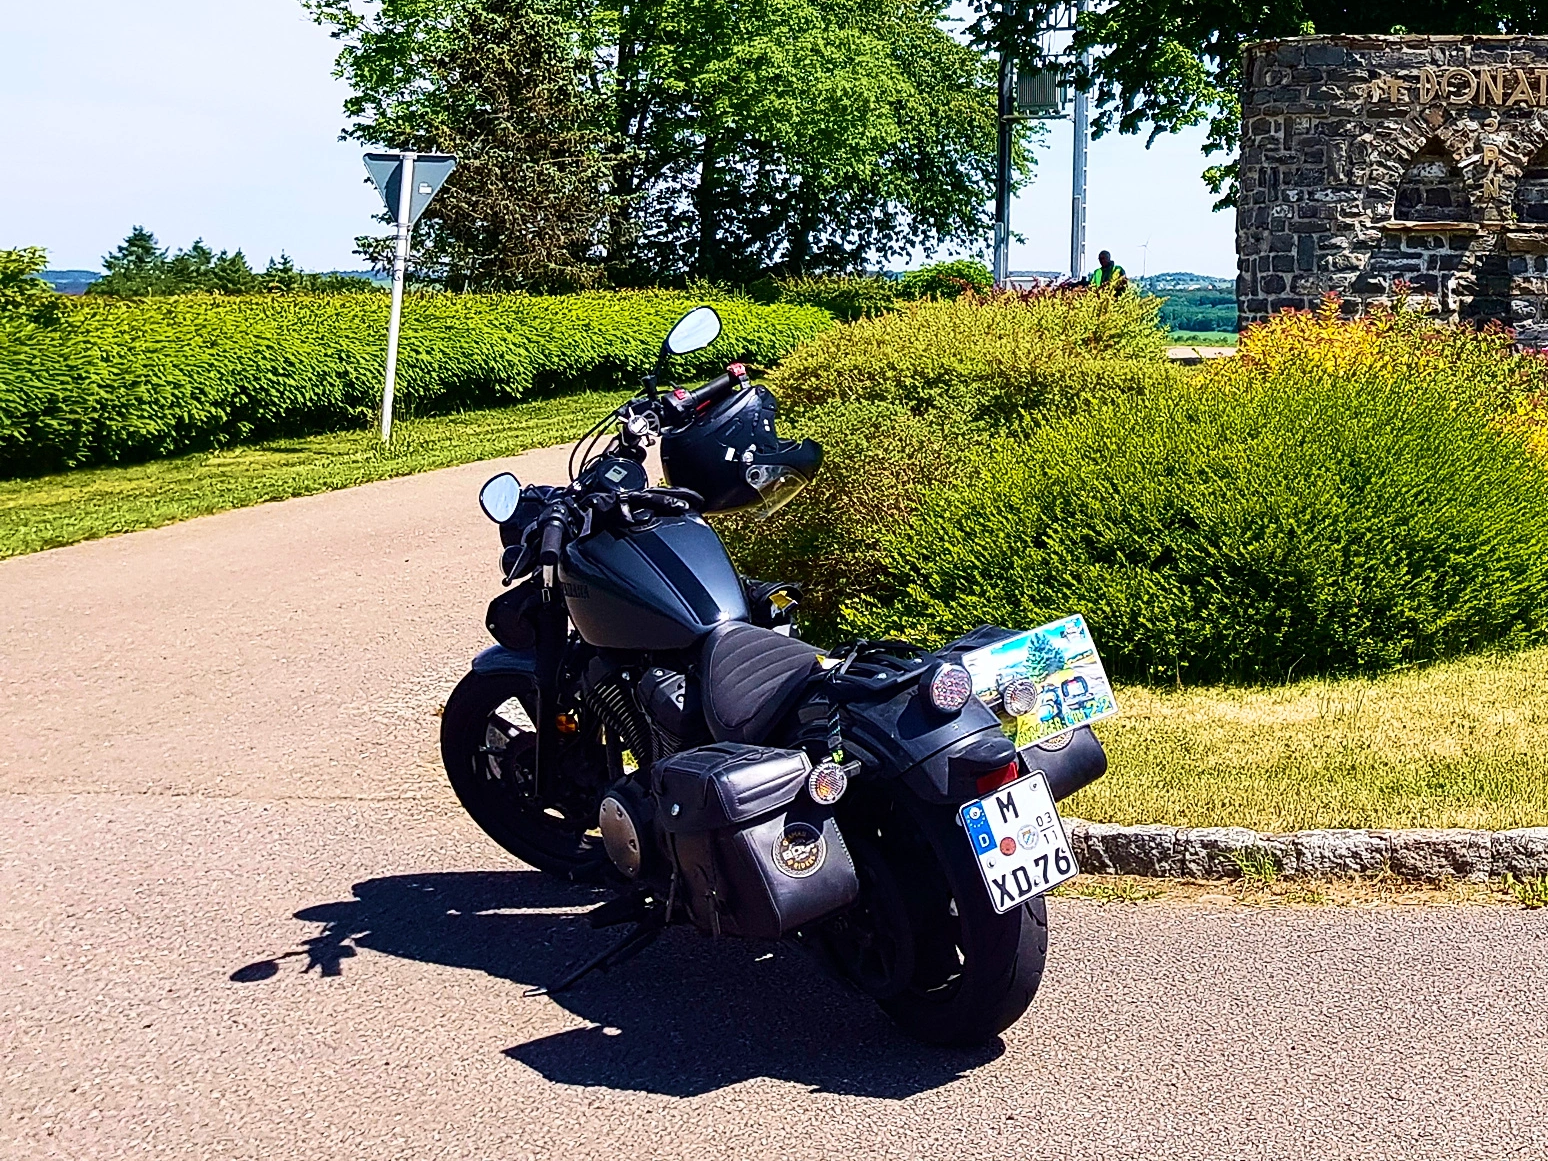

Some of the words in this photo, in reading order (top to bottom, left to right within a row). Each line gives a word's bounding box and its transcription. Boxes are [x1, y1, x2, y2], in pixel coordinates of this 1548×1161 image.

[1086, 695, 1110, 717] 22
[995, 791, 1019, 824] M
[1036, 811, 1053, 827] 03
[979, 833, 990, 848] D
[1044, 830, 1058, 845] 11
